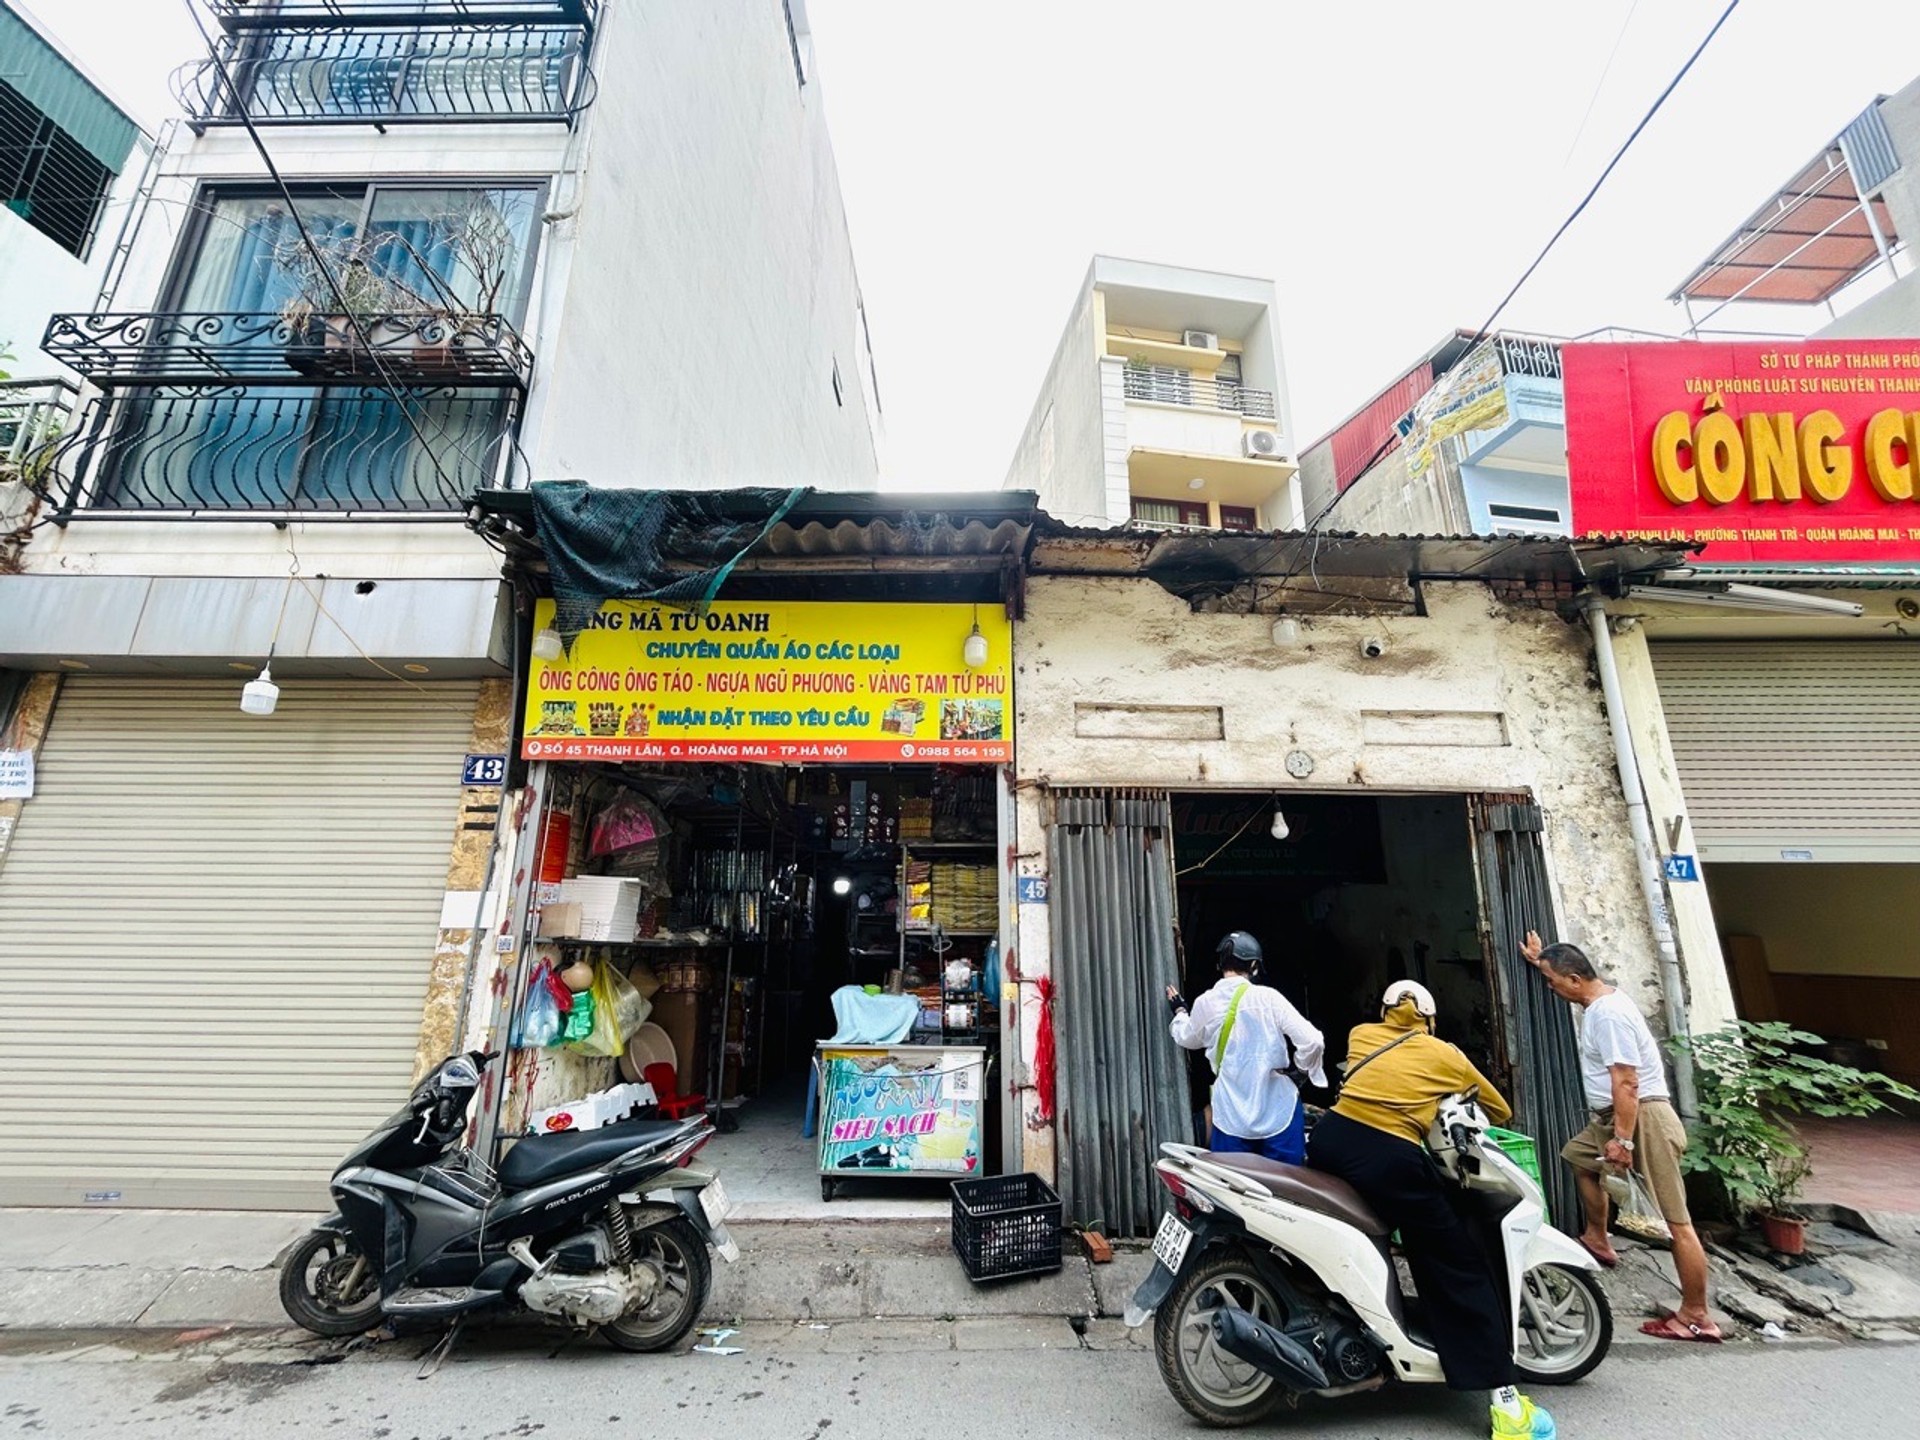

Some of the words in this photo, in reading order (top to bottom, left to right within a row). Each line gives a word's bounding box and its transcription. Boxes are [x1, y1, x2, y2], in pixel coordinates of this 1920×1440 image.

[1760, 350, 1779, 369] SỞ
[1783, 353, 1800, 368] TƯ
[1805, 350, 1841, 369] PHÁP
[1763, 375, 1797, 395] LUẬT
[1653, 391, 1853, 503] CÔNG
[1864, 408, 1920, 502] C
[1694, 526, 1738, 541] PHƯỜNG
[1741, 529, 1777, 541] THANH
[1806, 527, 1836, 543] QUẬN
[1877, 529, 1899, 541] MAI
[629, 608, 662, 631] MÃ
[705, 612, 770, 632] OANH
[646, 638, 722, 659] CHUYÊN
[783, 639, 811, 660] ÁO
[815, 639, 854, 660] CÁC
[858, 643, 900, 665] LOẠI
[540, 666, 571, 691] ÔNG
[577, 666, 620, 692] CÔNG
[625, 666, 657, 692] ÔNG
[663, 667, 693, 693] TÁO
[707, 671, 750, 699] NGỰA
[755, 668, 788, 693] NGŨ
[792, 671, 855, 694] PHƯƠNG
[869, 669, 911, 694] VÀNG
[916, 673, 948, 694] TAM
[952, 669, 972, 694] TỨ
[976, 666, 1005, 694] PHỦ
[657, 706, 706, 730] NHẬN
[709, 706, 746, 730] ĐẶT
[749, 710, 793, 726] THEO
[796, 707, 830, 727] YÊU
[544, 741, 564, 754] SỐ
[566, 745, 582, 755] 45
[585, 745, 632, 756] THANH
[671, 745, 684, 755] Q.
[689, 743, 737, 756] HOÀNG
[742, 746, 769, 756] MAI
[824, 743, 848, 758] NỘI
[918, 745, 949, 756] 0988
[954, 746, 977, 757] 564
[982, 747, 1005, 758] 195
[467, 758, 503, 780] 43
[1667, 859, 1688, 877] 47
[1024, 880, 1047, 899] 45
